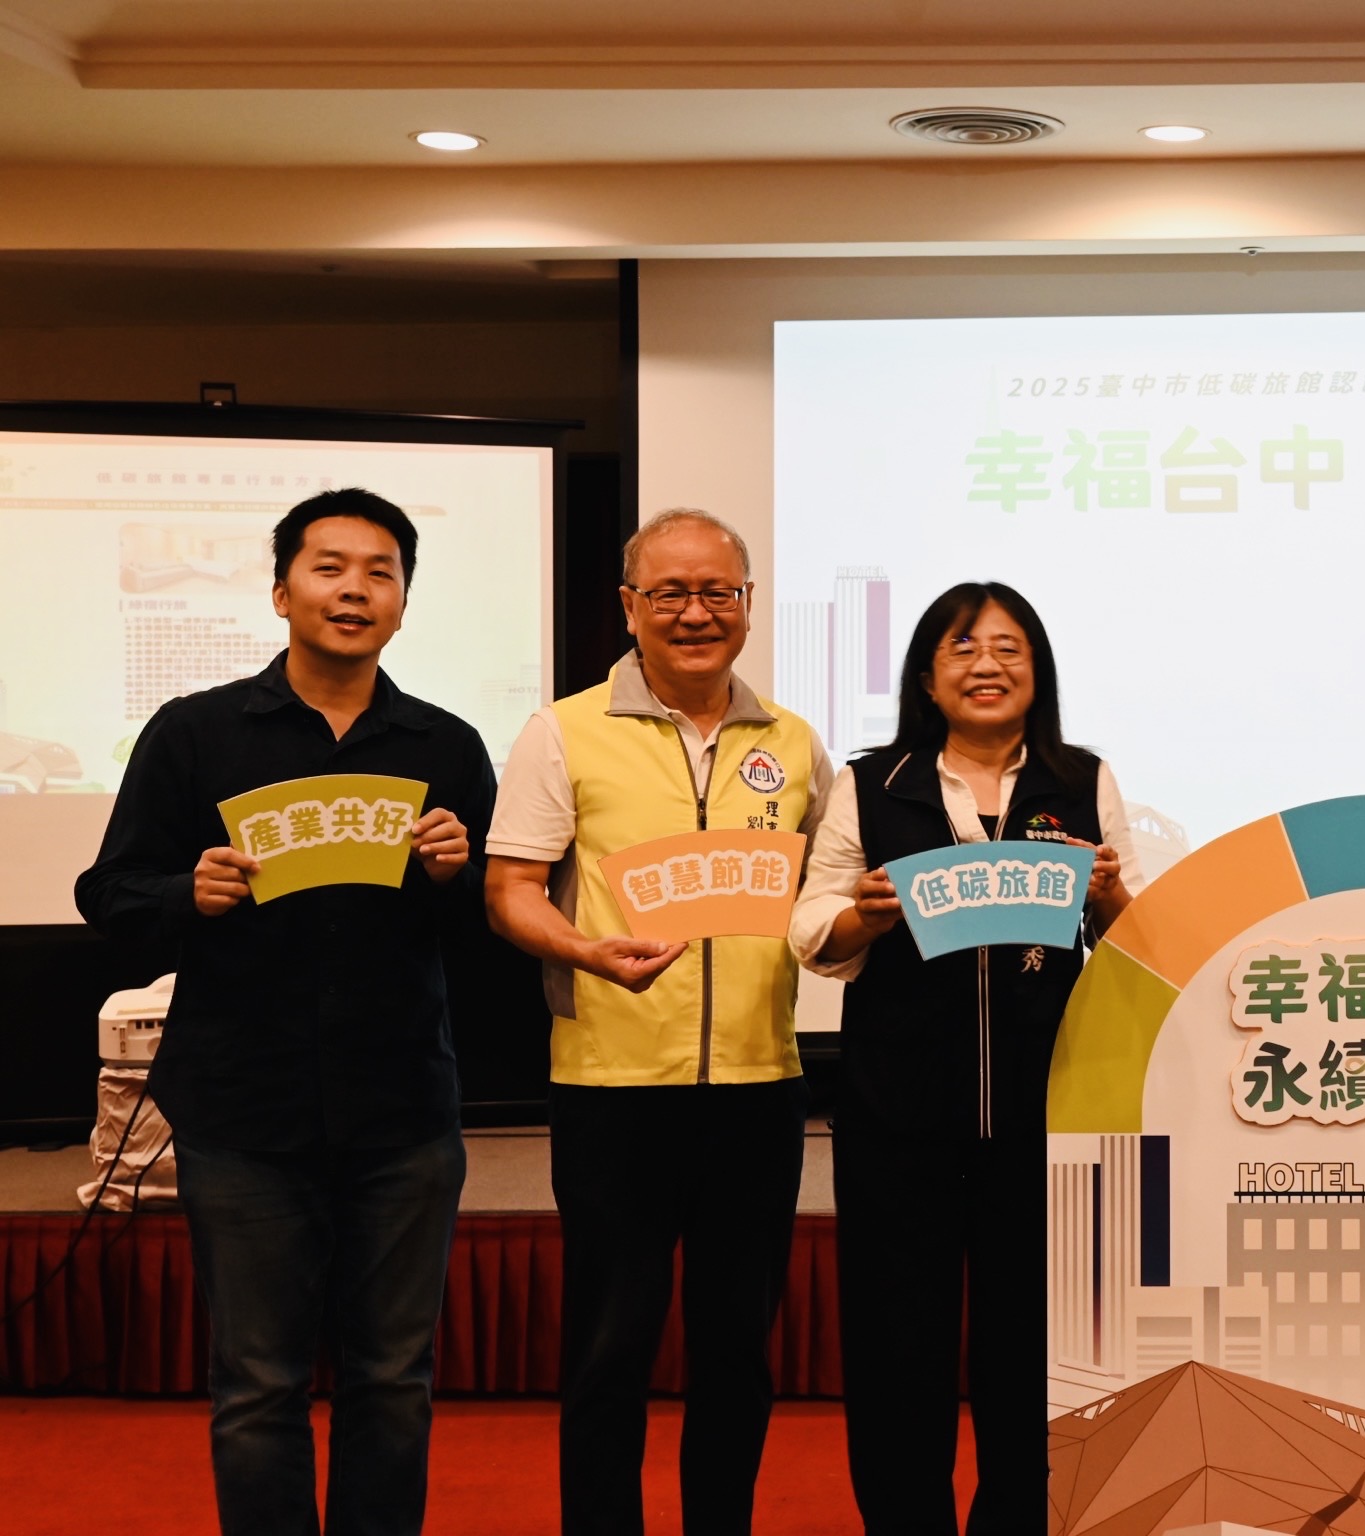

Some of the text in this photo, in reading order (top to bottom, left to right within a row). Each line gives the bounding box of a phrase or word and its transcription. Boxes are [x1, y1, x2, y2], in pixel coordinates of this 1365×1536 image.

[965, 424, 1344, 513] 幸福台中
[245, 803, 407, 856] 產業共好
[628, 856, 785, 906] 智慧節能
[917, 866, 1070, 911] 低碳旅館
[1021, 945, 1045, 973] 秀
[1239, 1162, 1365, 1193] HOTEL
